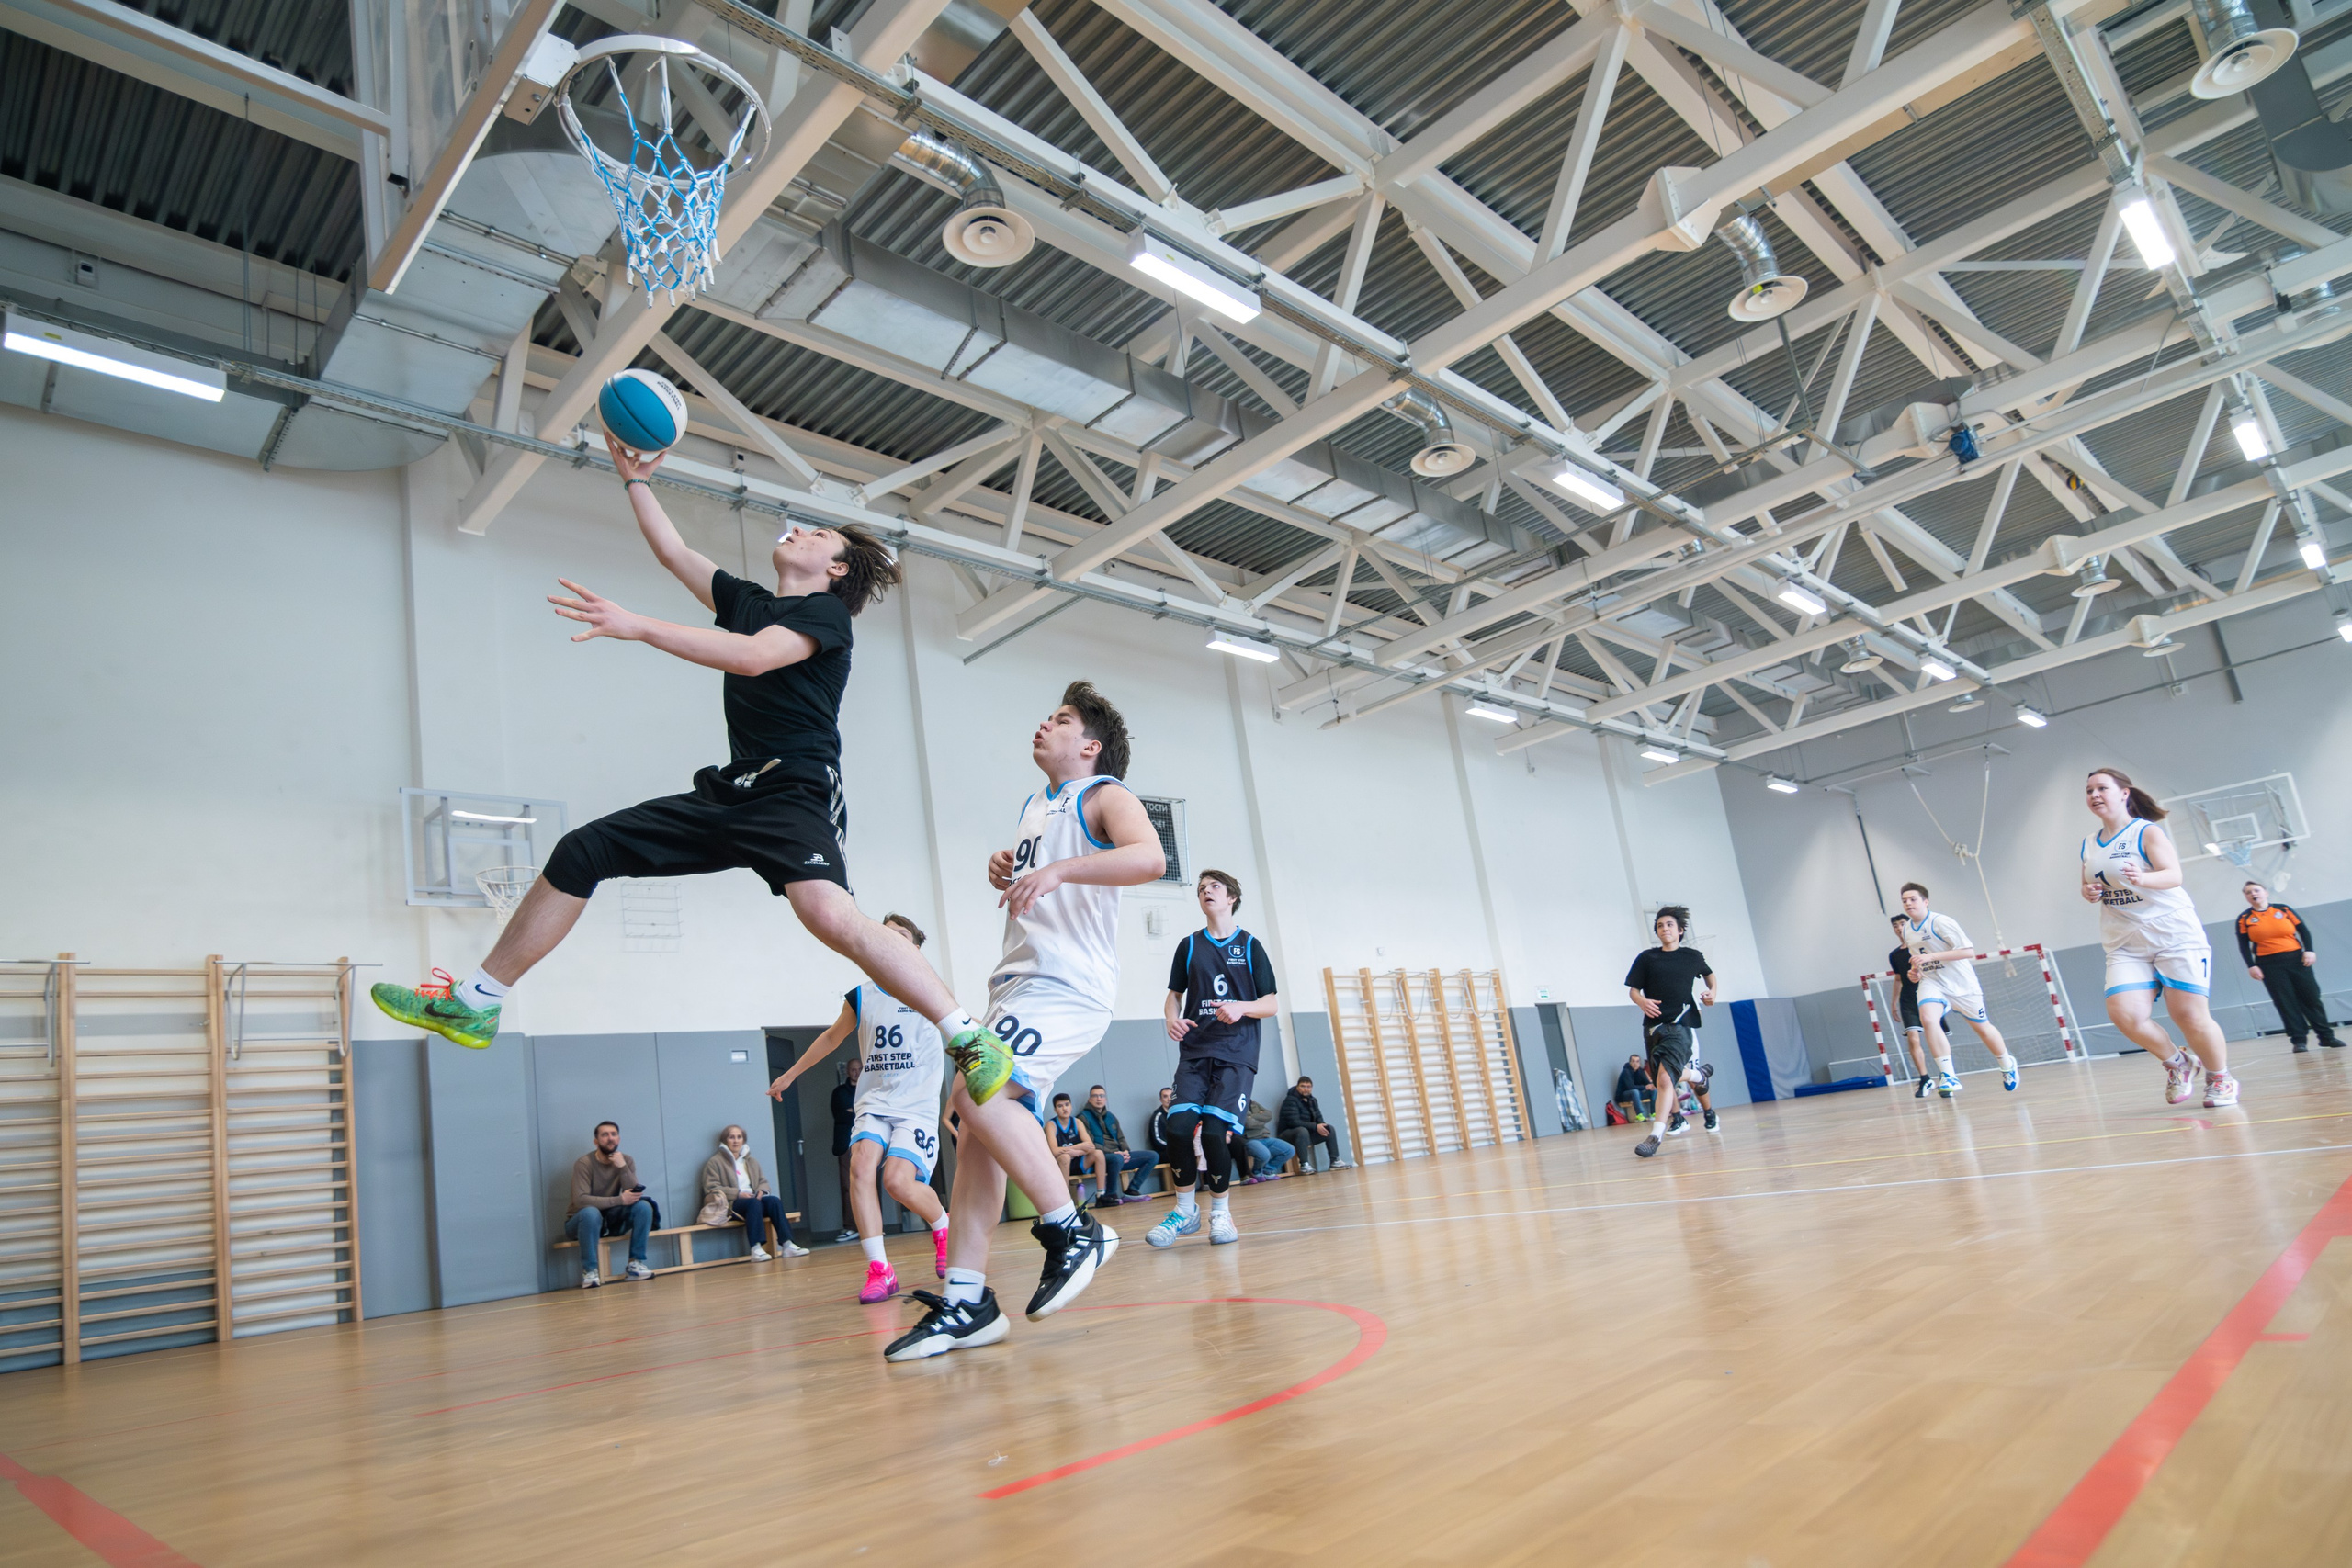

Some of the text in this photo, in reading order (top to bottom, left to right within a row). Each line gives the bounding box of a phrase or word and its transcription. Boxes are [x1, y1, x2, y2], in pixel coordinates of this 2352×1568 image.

[2201, 958, 2207, 978] 1
[1213, 974, 1228, 996] 6
[1978, 1008, 1984, 1018] 5
[874, 1024, 904, 1049] 86
[995, 1015, 1042, 1056] 90
[864, 1061, 916, 1072] BASKETBALL
[866, 1053, 912, 1063] FIRST STEP
[1238, 1093, 1247, 1112] 6
[914, 1128, 935, 1158] 86
